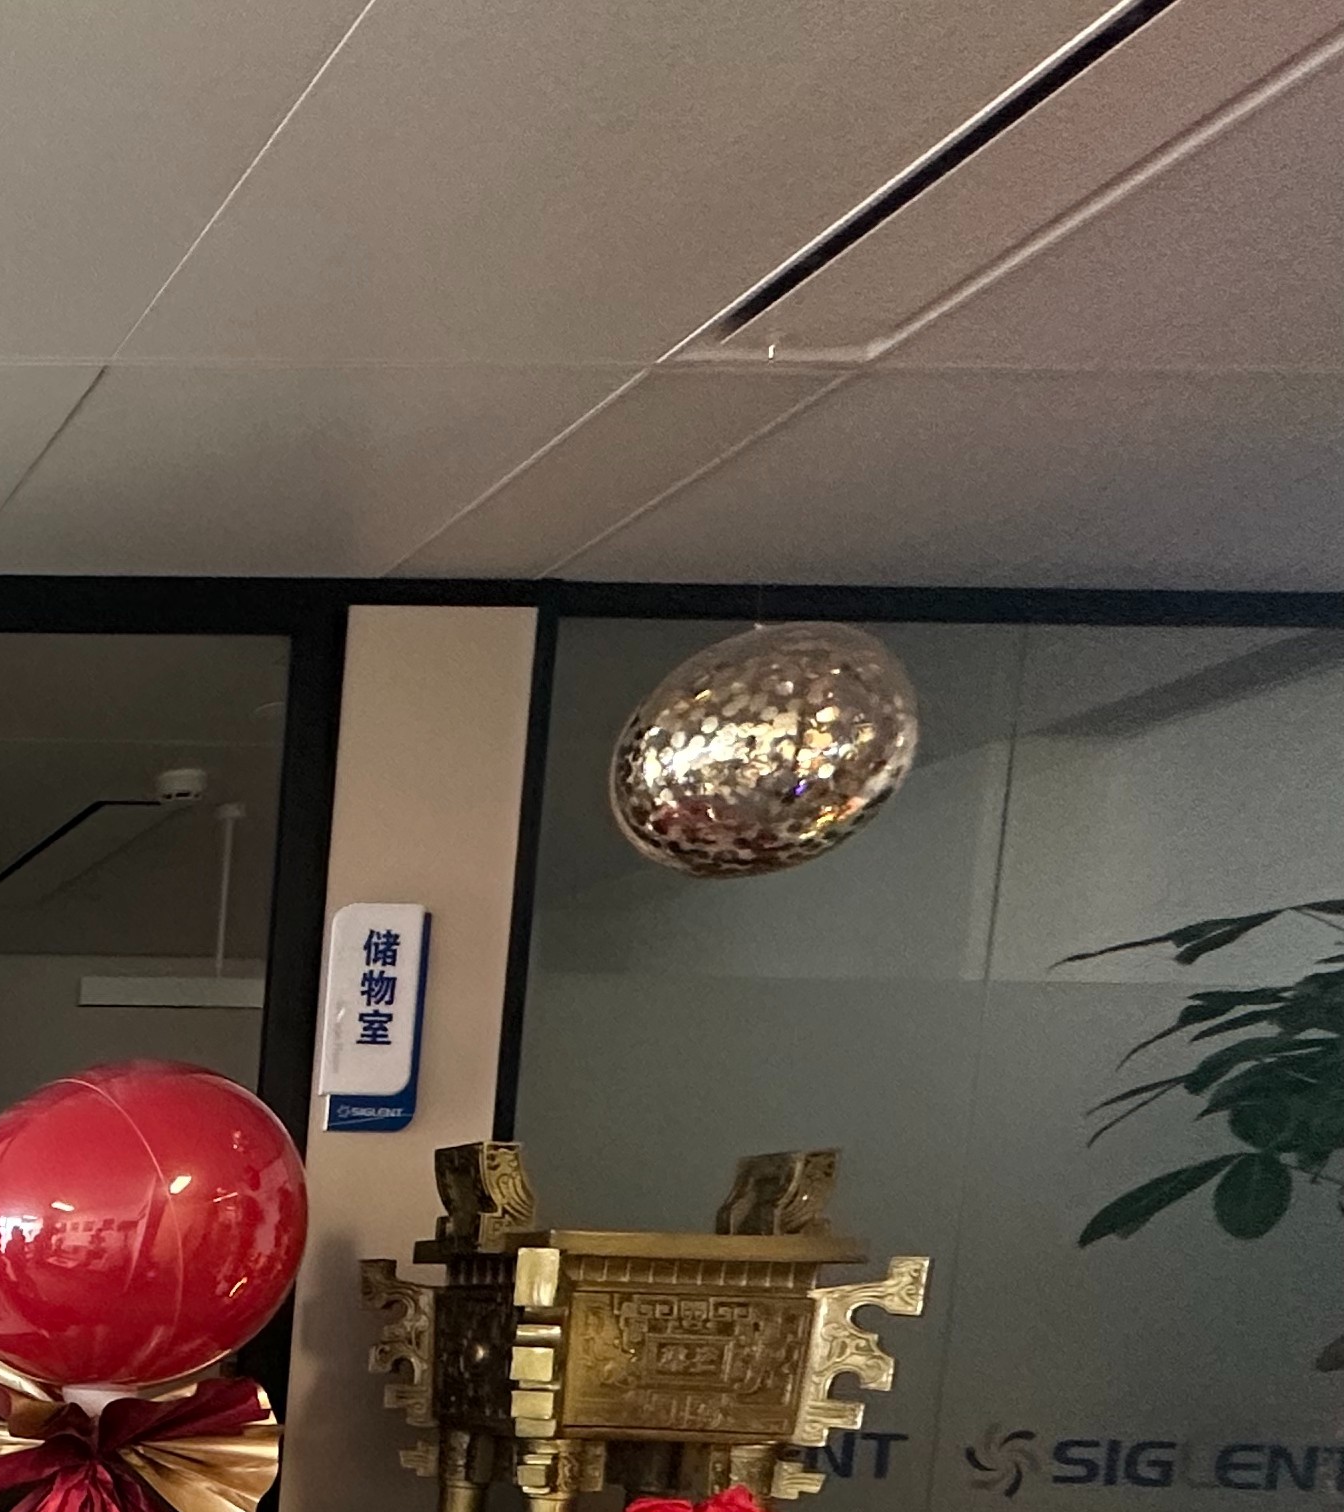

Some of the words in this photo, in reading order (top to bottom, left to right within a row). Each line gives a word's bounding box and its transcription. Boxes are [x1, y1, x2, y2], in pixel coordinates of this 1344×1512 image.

[356, 929, 401, 1046] 储物室
[351, 1106, 404, 1118] SIGLENT
